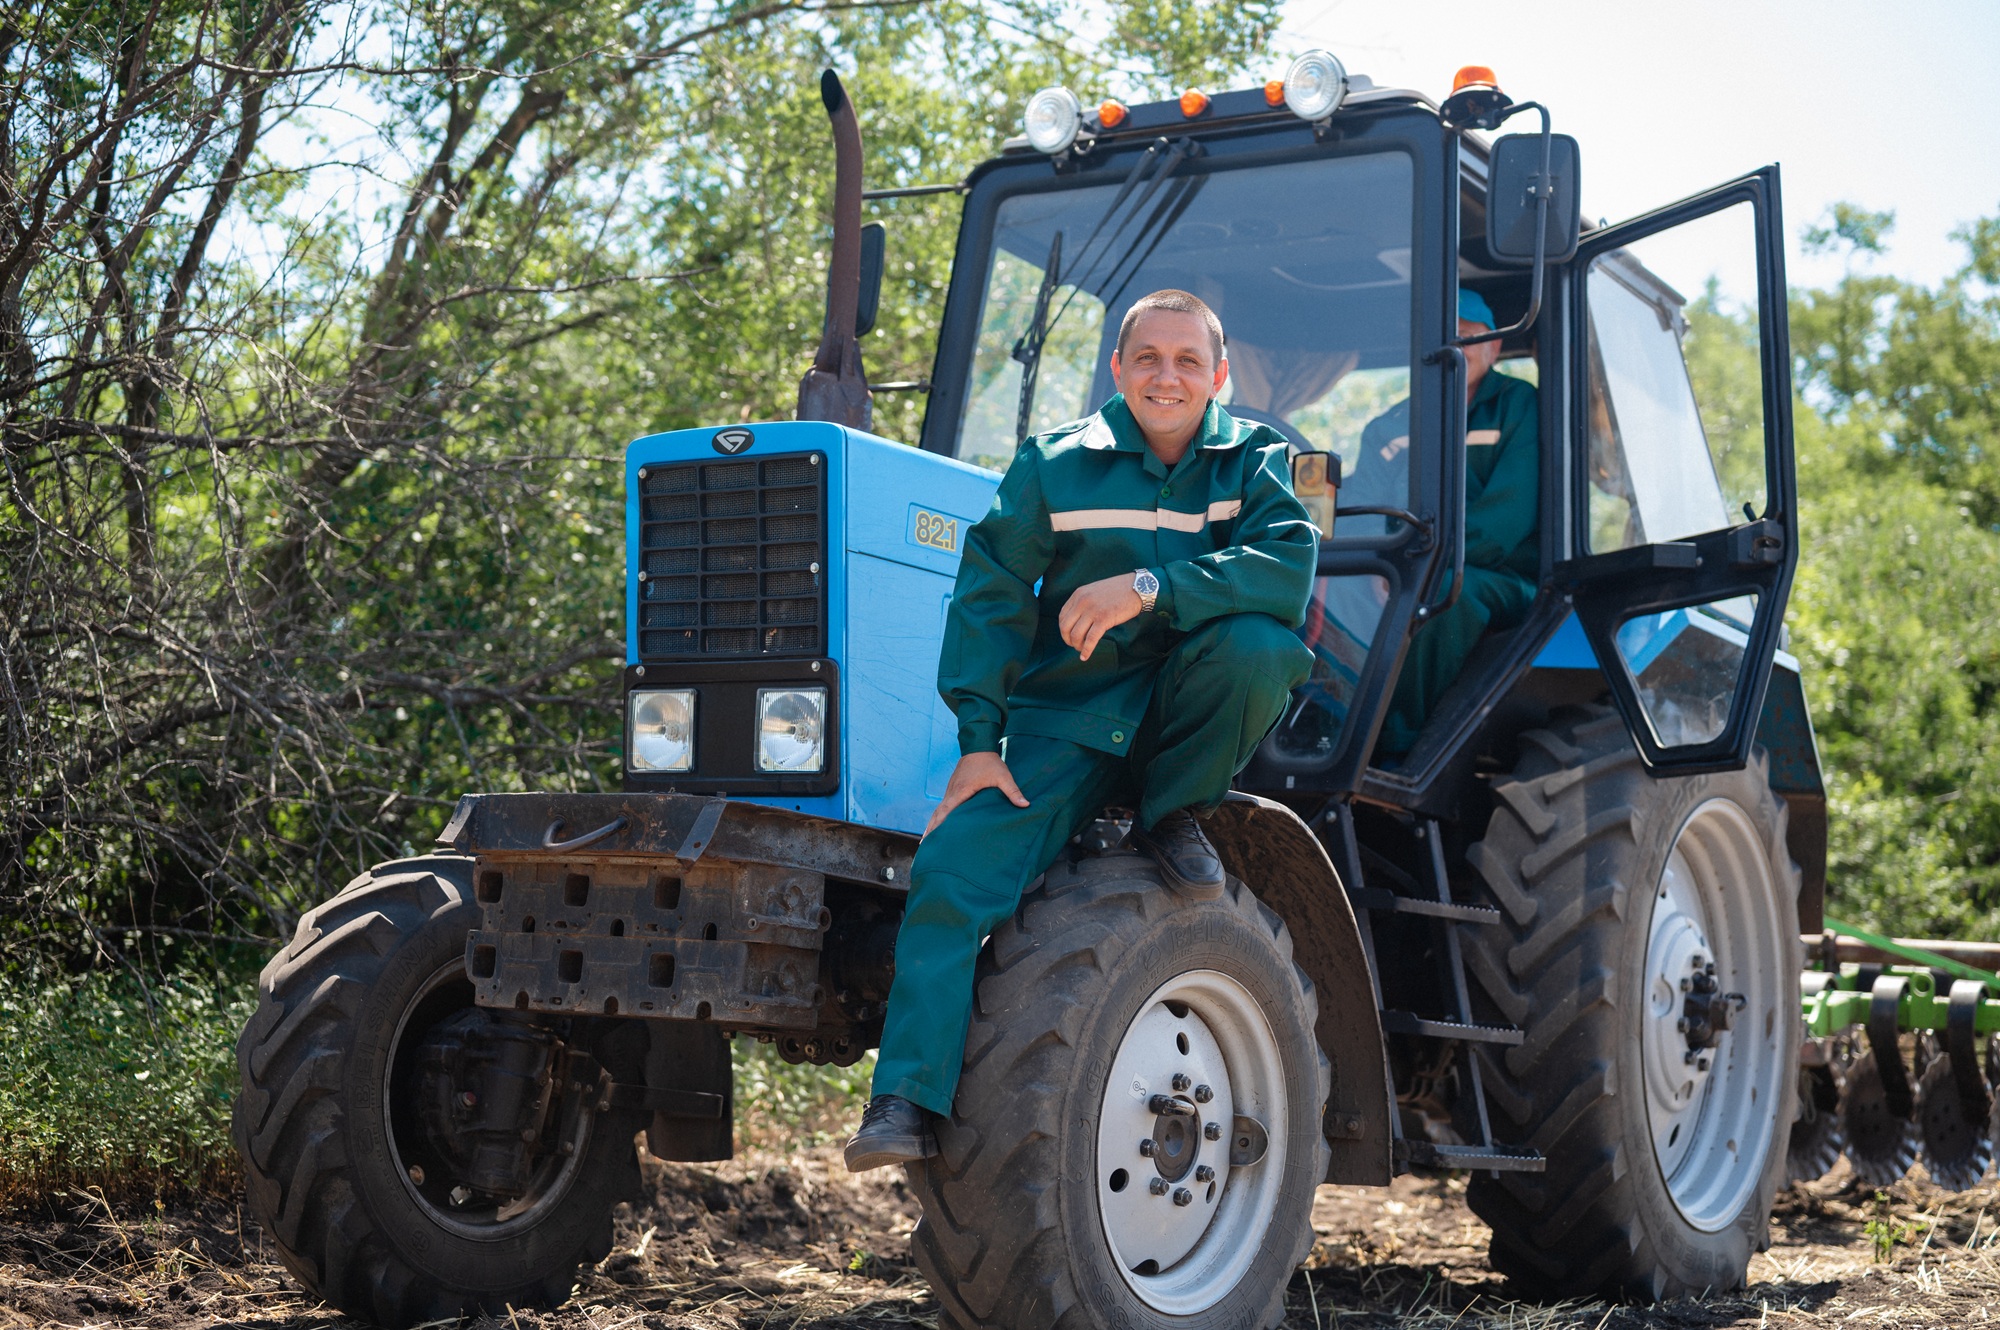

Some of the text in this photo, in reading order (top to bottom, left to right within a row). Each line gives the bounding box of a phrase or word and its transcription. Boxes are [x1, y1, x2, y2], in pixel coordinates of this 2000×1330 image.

[915, 510, 957, 552] 82.1
[1169, 920, 1289, 998] BELSHINA
[353, 934, 438, 1108] BELSHINA
